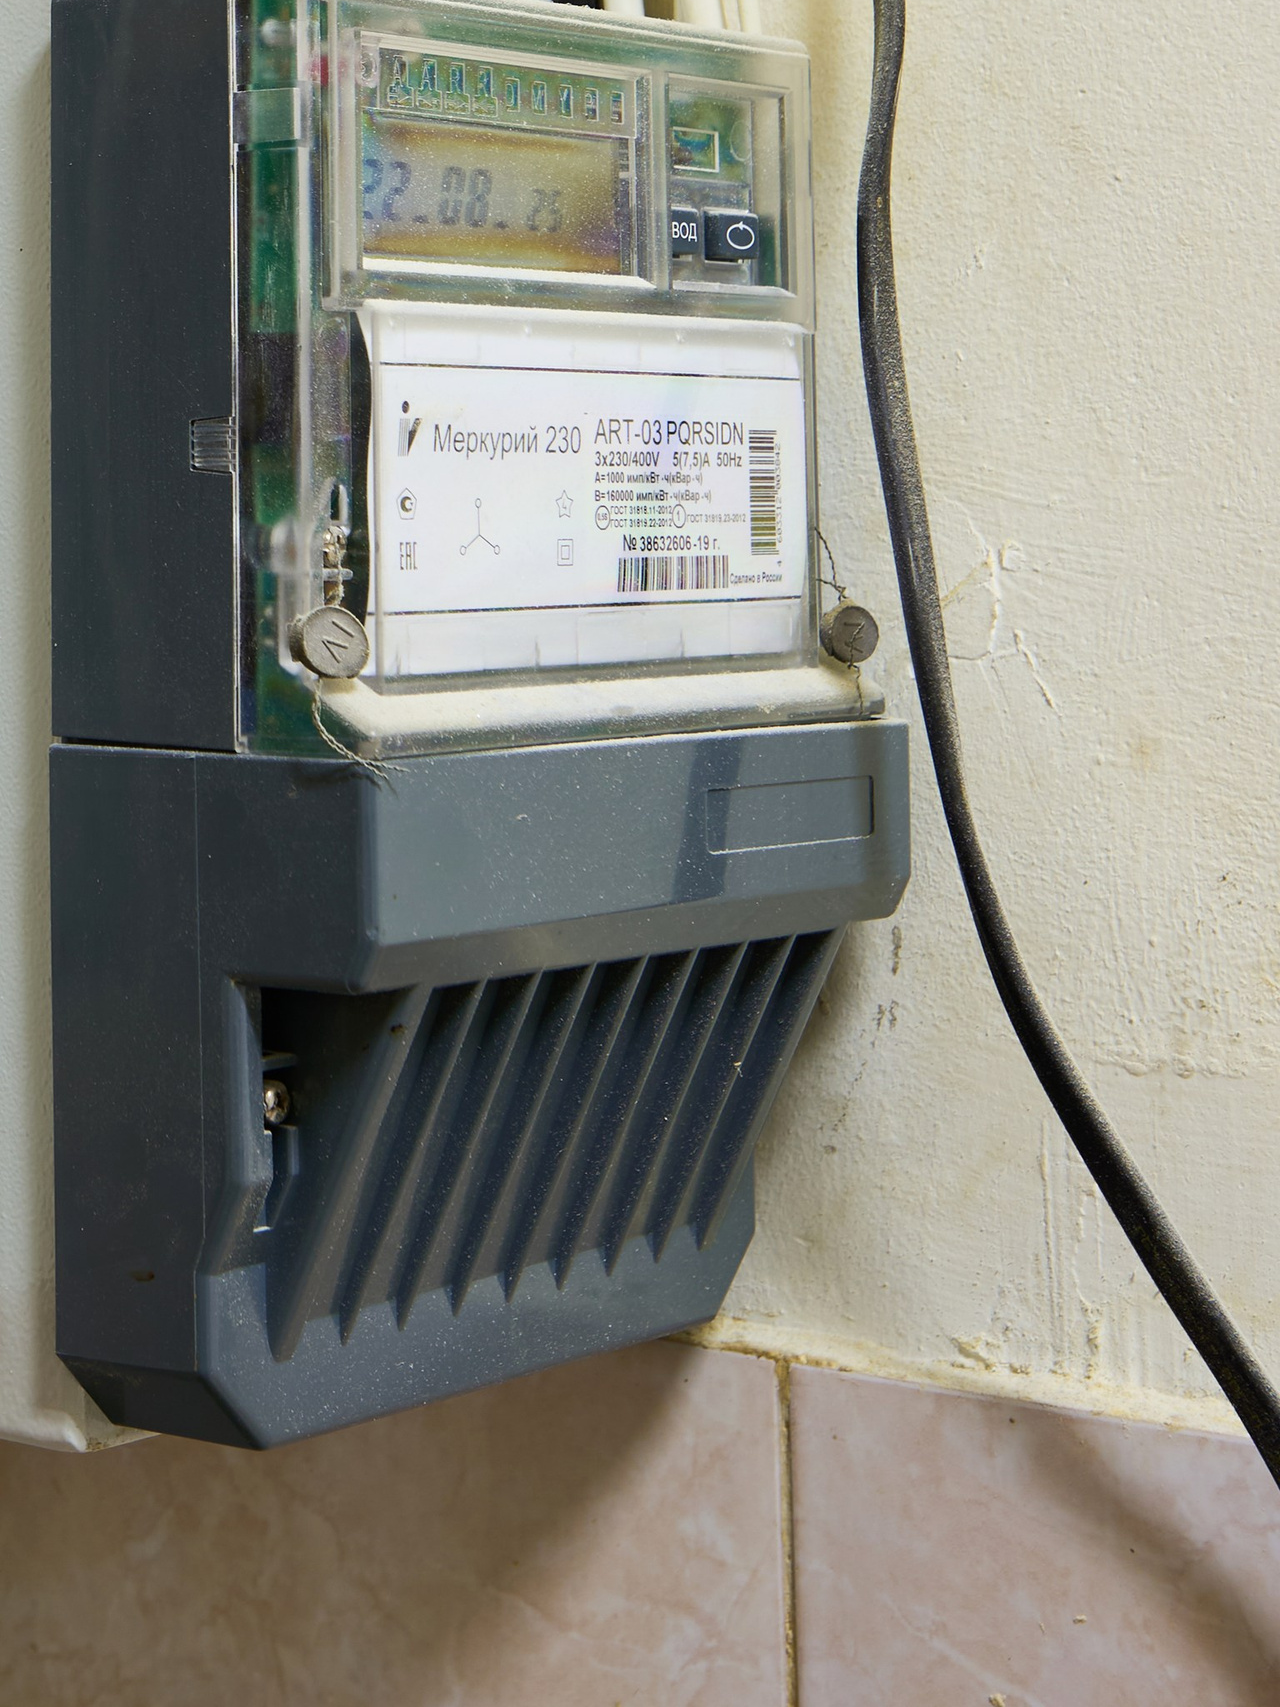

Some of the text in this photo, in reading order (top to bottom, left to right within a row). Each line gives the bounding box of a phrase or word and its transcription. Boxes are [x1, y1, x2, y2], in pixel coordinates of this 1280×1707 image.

[594, 418, 744, 446] ART-03 PQRSIDN
[433, 423, 582, 460] Меркурий 230
[594, 451, 743, 471] 3x230/400V 5(7,5)A 50Hz
[610, 505, 628, 515] ГОСТ
[610, 518, 628, 528] ГОСТ
[687, 513, 703, 523] ГОСТ
[730, 572, 756, 586] Сделано
[762, 571, 783, 583] России
